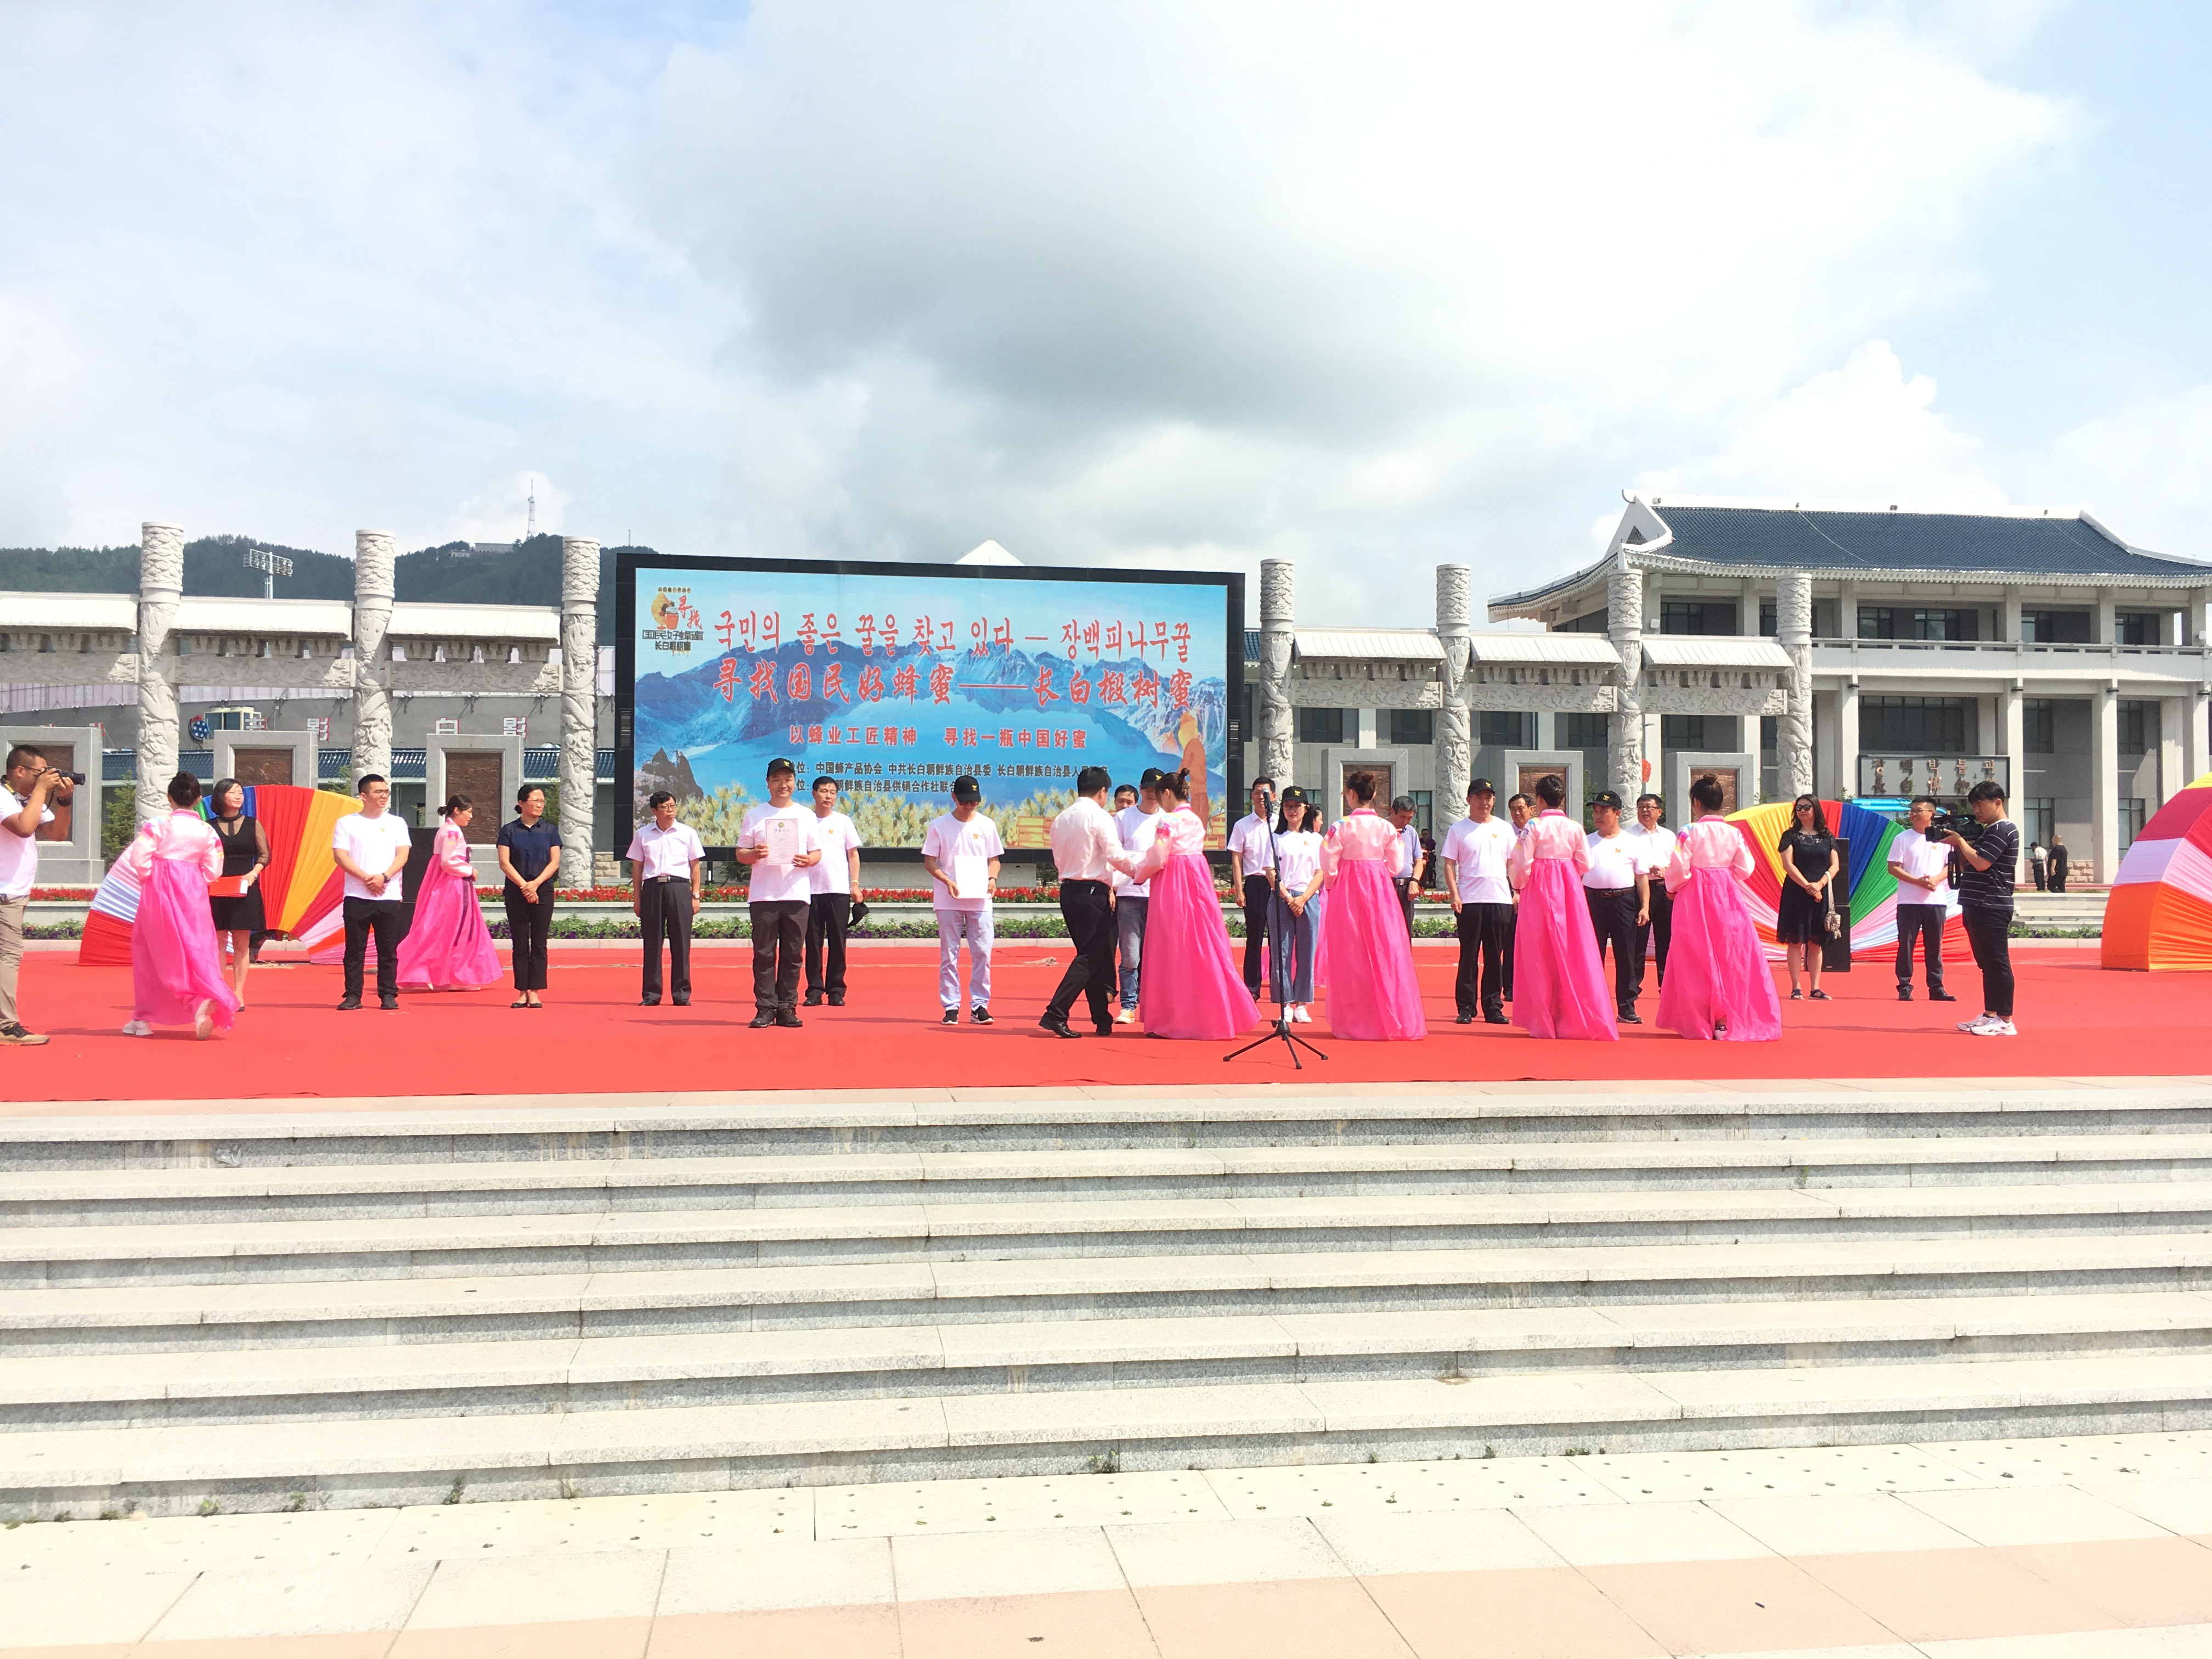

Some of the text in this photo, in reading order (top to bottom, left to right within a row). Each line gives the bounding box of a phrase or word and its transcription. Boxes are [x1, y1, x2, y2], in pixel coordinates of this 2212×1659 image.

[642, 629, 703, 641] 国民好蜂蜜
[715, 611, 780, 653] 국민의
[797, 612, 842, 656] 좋은
[855, 613, 899, 657] 꿀을
[913, 615, 956, 657] 찾고
[971, 617, 1014, 658] 있다
[1060, 618, 1191, 663] 장백피나무꿀
[790, 724, 1086, 749] 以蜂业工匠精神 寻找一瓶中国好蜜
[816, 761, 882, 775] 中国蜂产品协会
[889, 763, 991, 777] 中共长白朝鲜族自治县委
[997, 764, 1108, 777] 长白朝鲜族自治县人
